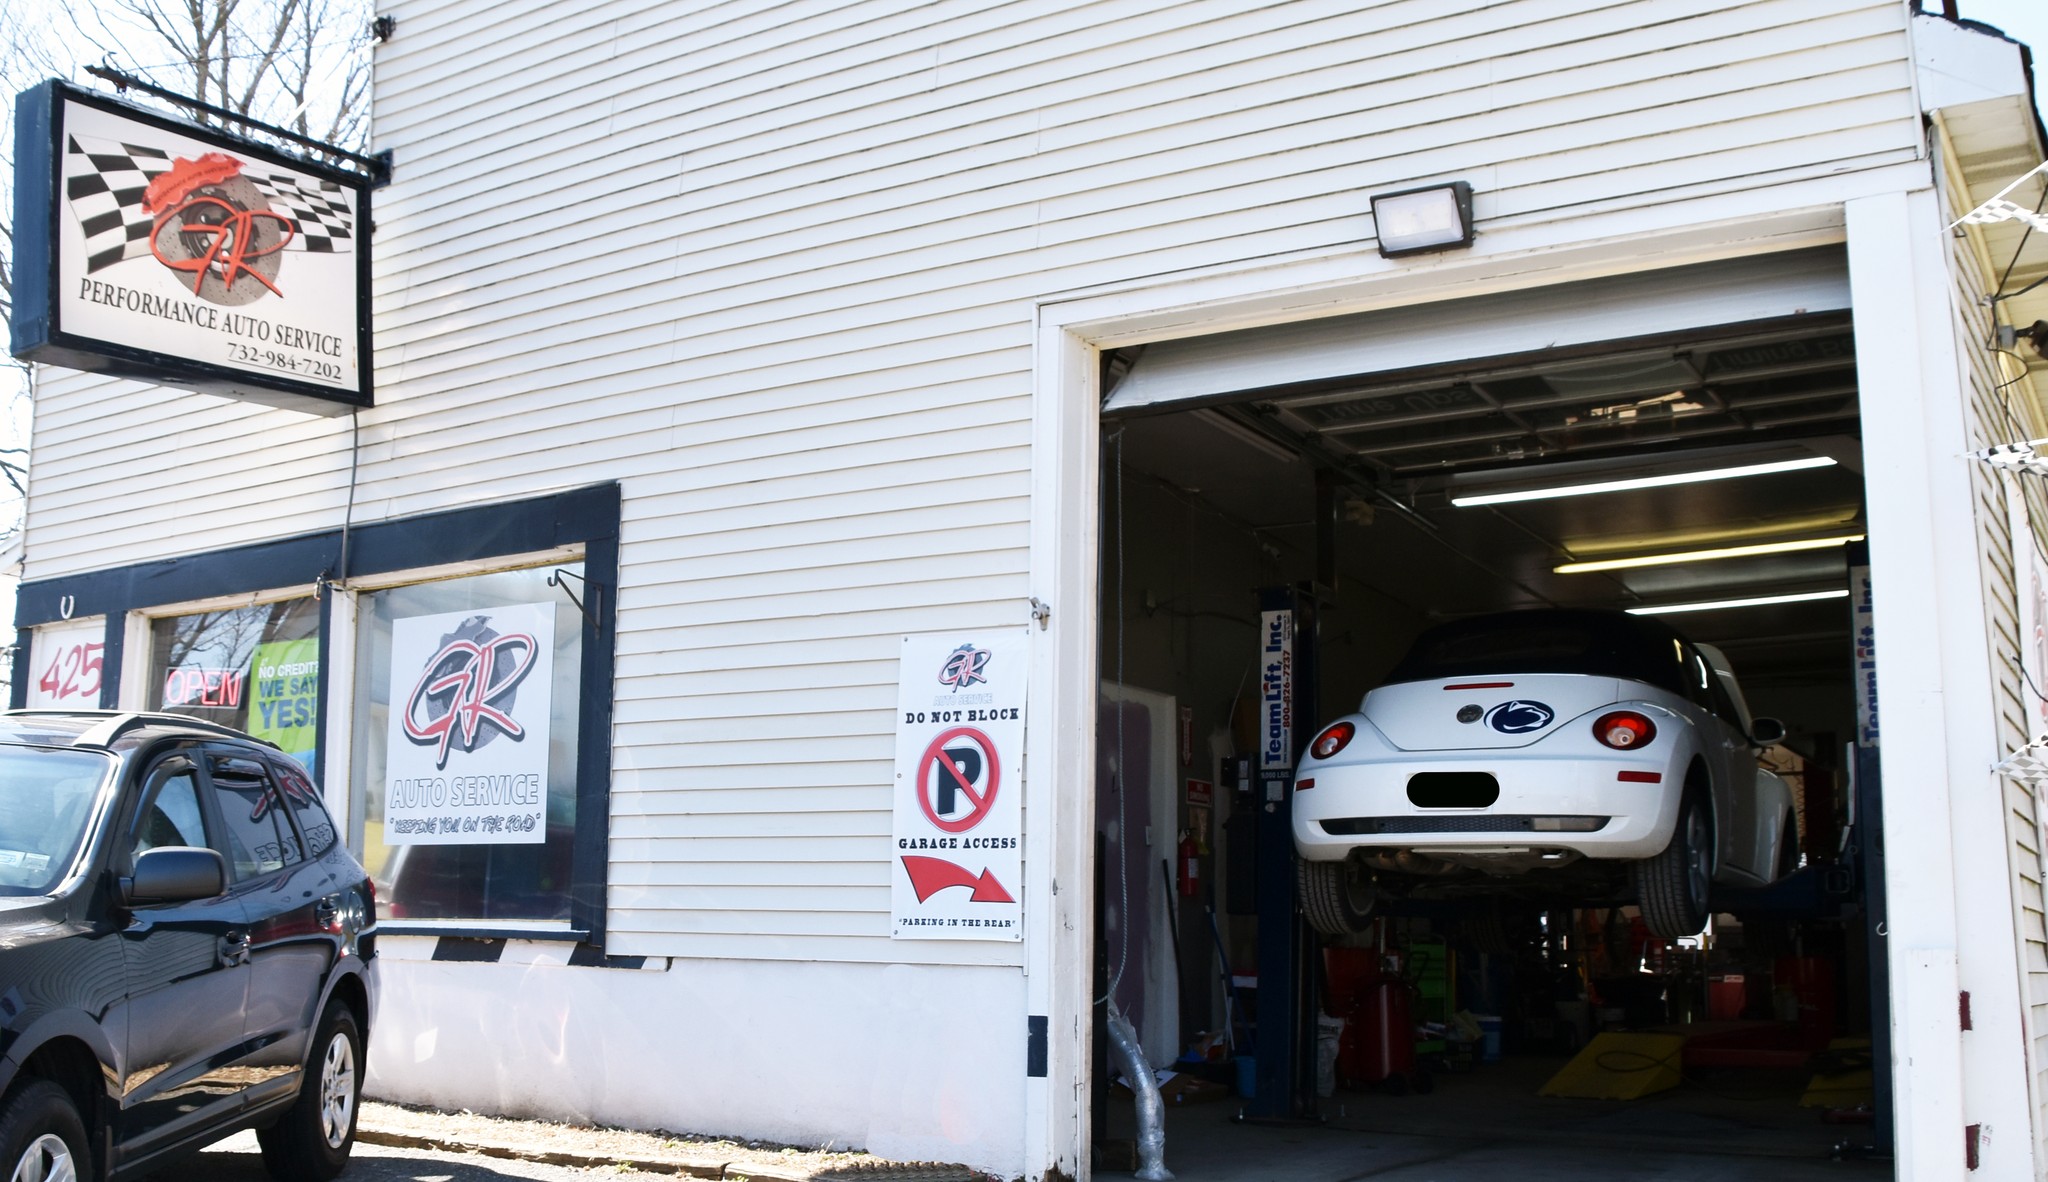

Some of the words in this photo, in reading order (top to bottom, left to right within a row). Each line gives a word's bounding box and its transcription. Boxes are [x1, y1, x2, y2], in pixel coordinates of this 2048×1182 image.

[79, 277, 218, 330] PERFORMANCE
[221, 312, 270, 341] AUTO
[275, 324, 343, 357] SERVICE
[227, 341, 342, 380] 732-984-7202
[1266, 614, 1282, 653] Inc.
[40, 642, 104, 700] 425
[258, 665, 275, 679] NO
[259, 679, 285, 698] WE
[290, 676, 318, 696] SAY
[166, 670, 241, 706] OPEN
[1283, 650, 1291, 728] 800-826-7237
[258, 697, 317, 729] YES!
[905, 712, 925, 724] DO
[931, 711, 962, 723] NOT
[968, 708, 1019, 722] BLOCK
[390, 777, 447, 808] AUTO
[451, 774, 539, 807] SERVICE
[439, 817, 461, 834] YOU
[462, 816, 480, 832] ON
[481, 815, 505, 834] THE
[898, 838, 958, 849] GARAGE
[963, 838, 1017, 849] ACCESS
[961, 919, 981, 927] THE
